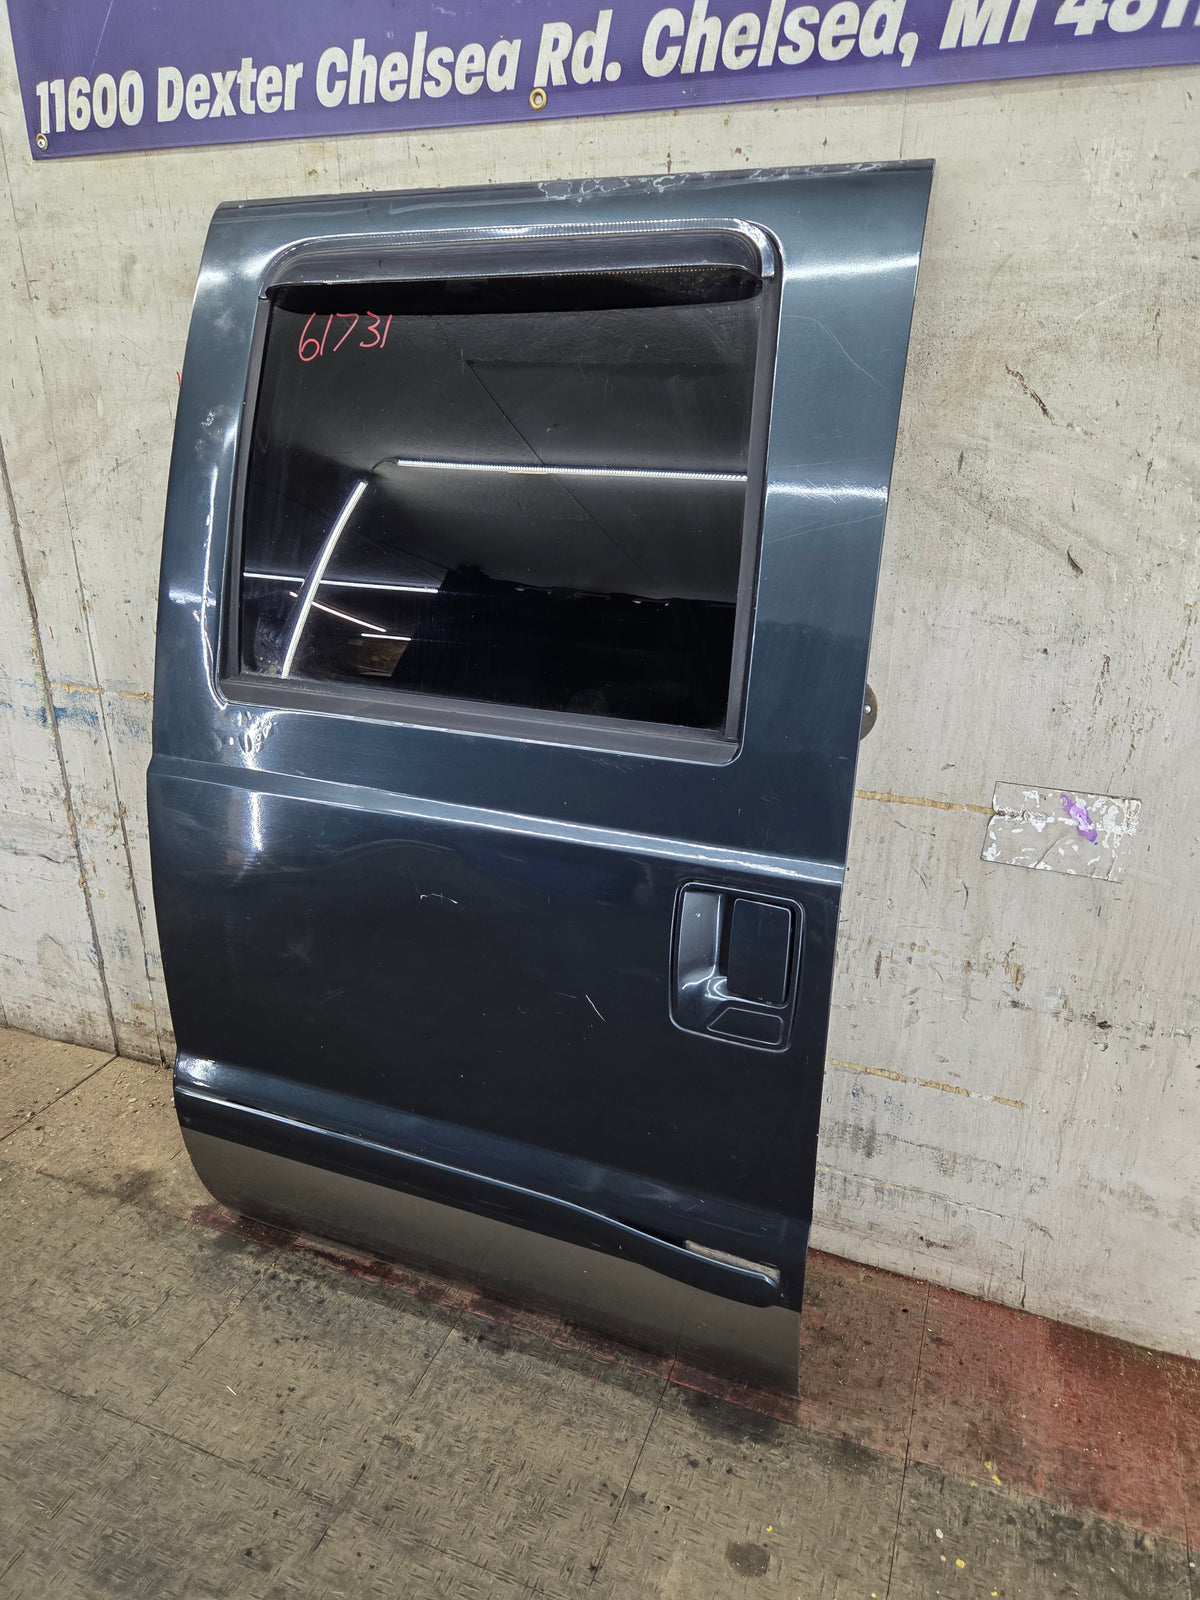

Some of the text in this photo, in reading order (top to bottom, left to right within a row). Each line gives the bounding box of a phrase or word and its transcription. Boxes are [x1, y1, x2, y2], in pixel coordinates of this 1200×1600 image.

[36, 69, 145, 133] 11600
[157, 57, 303, 122] Dexter
[316, 30, 522, 108] Chelsea
[534, 9, 621, 88] Rd.
[642, 0, 918, 77] Chelsea,
[939, 0, 1038, 49] MI
[298, 310, 393, 362] 61731
